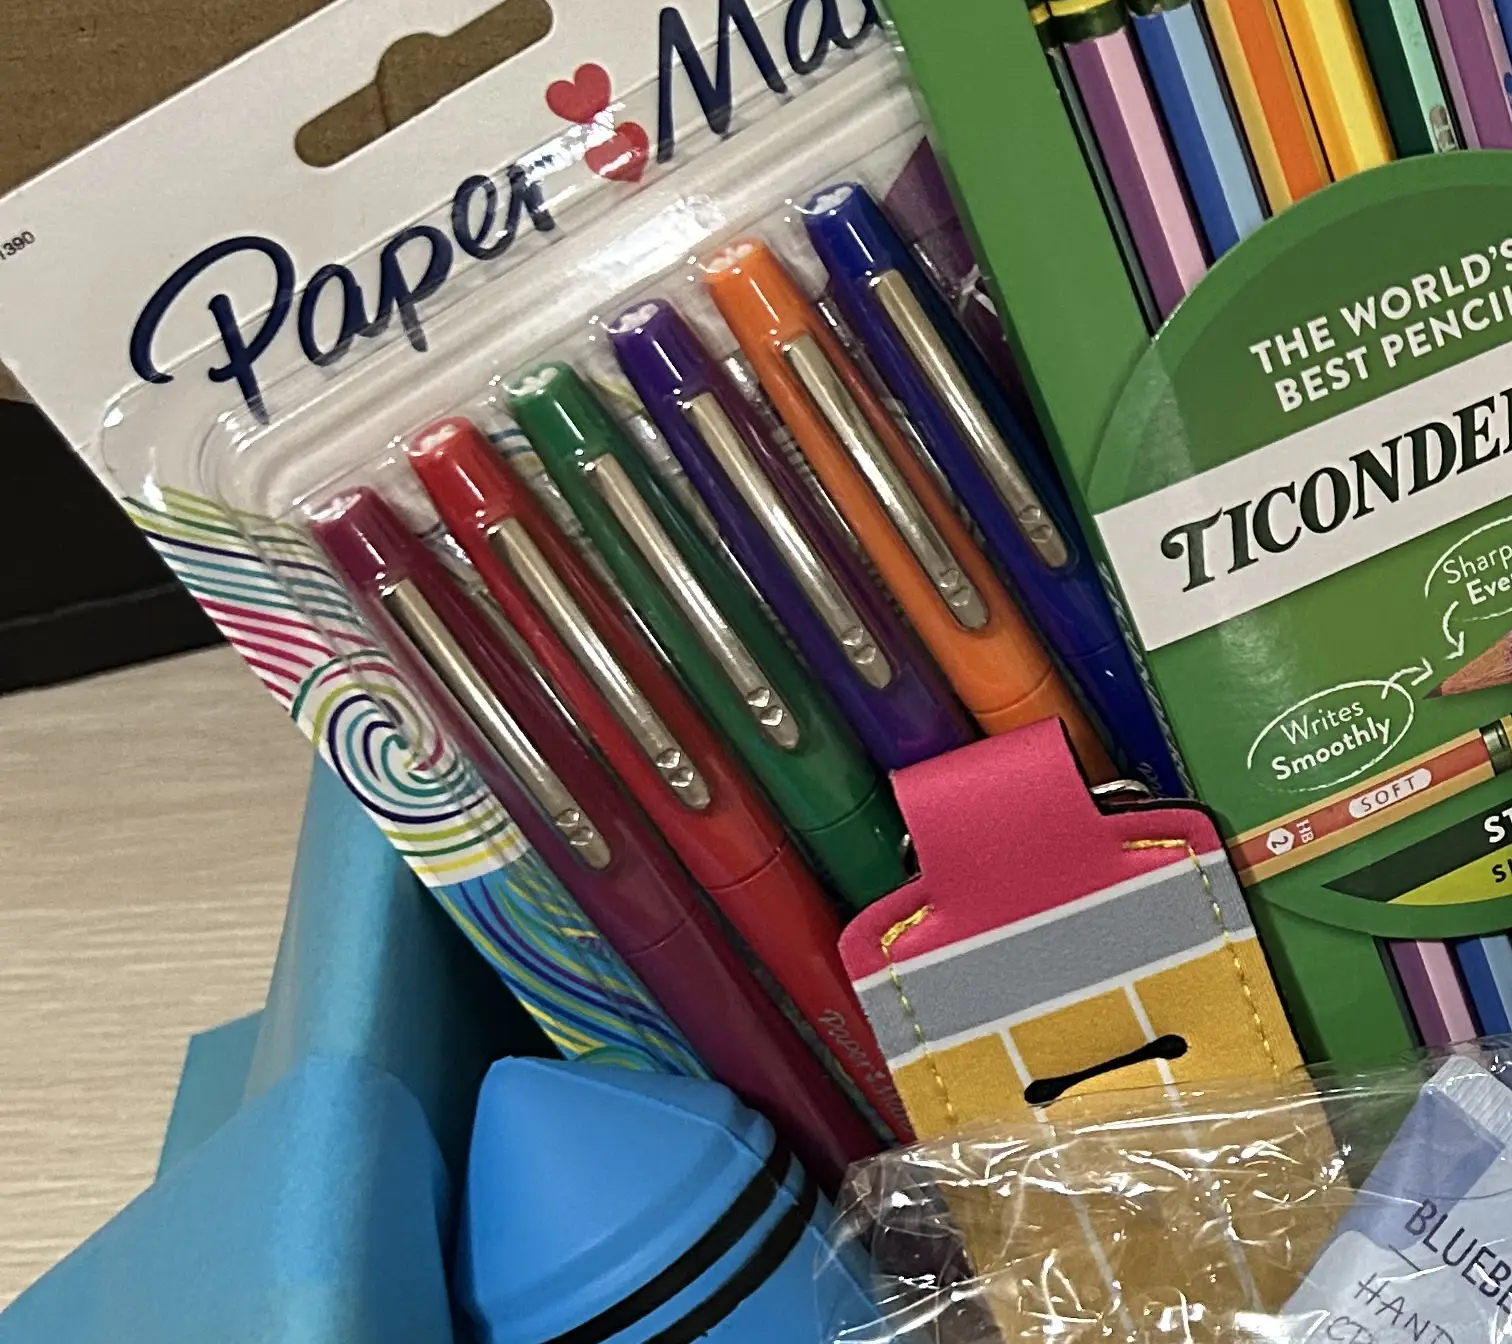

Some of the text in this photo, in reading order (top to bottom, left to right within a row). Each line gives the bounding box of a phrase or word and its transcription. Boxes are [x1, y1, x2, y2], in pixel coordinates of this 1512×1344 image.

[129, 163, 556, 424] Paper
[1249, 316, 1336, 375] THE
[1274, 346, 1371, 413] BEST
[1271, 717, 1391, 781] Smoothly
[1280, 700, 1364, 746] Writes
[1271, 775, 1416, 850] 2 HB SOFT
